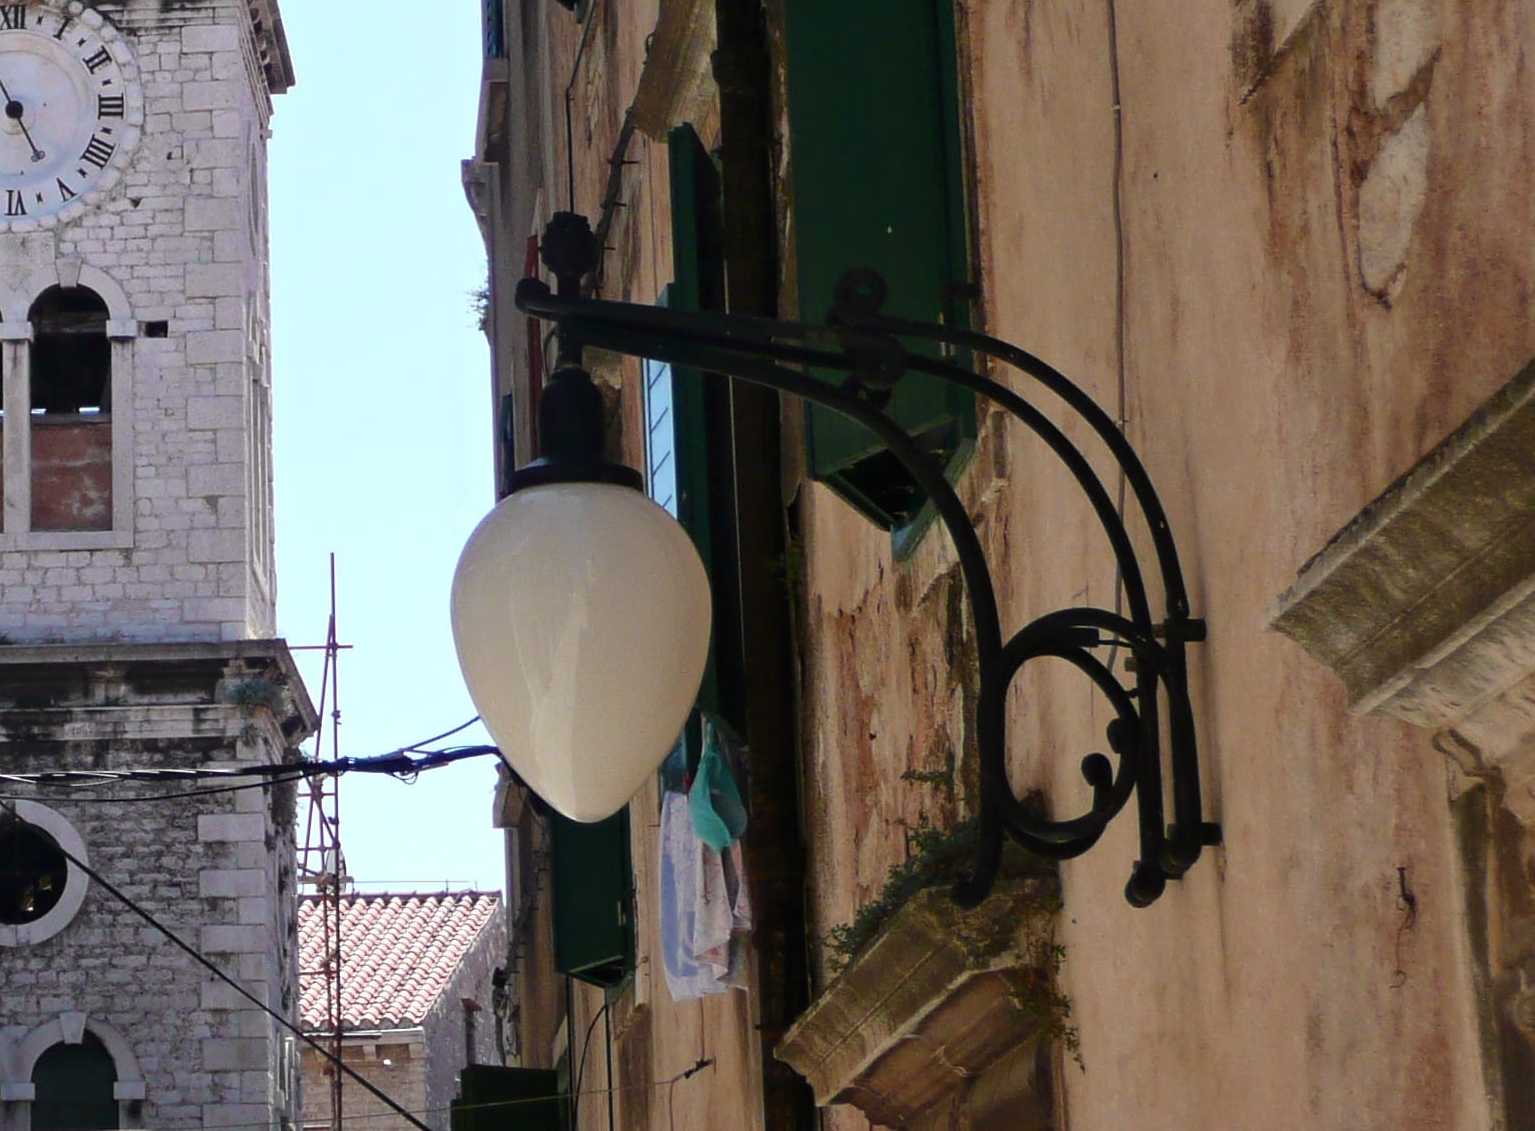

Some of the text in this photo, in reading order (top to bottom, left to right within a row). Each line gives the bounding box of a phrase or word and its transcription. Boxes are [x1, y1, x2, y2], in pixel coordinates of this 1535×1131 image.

[0, 4, 27, 30] XII
[53, 17, 73, 40] I
[82, 45, 113, 75] II
[98, 93, 124, 120] III
[80, 134, 116, 170] IIII
[5, 189, 28, 216] VI
[56, 177, 78, 202] V
